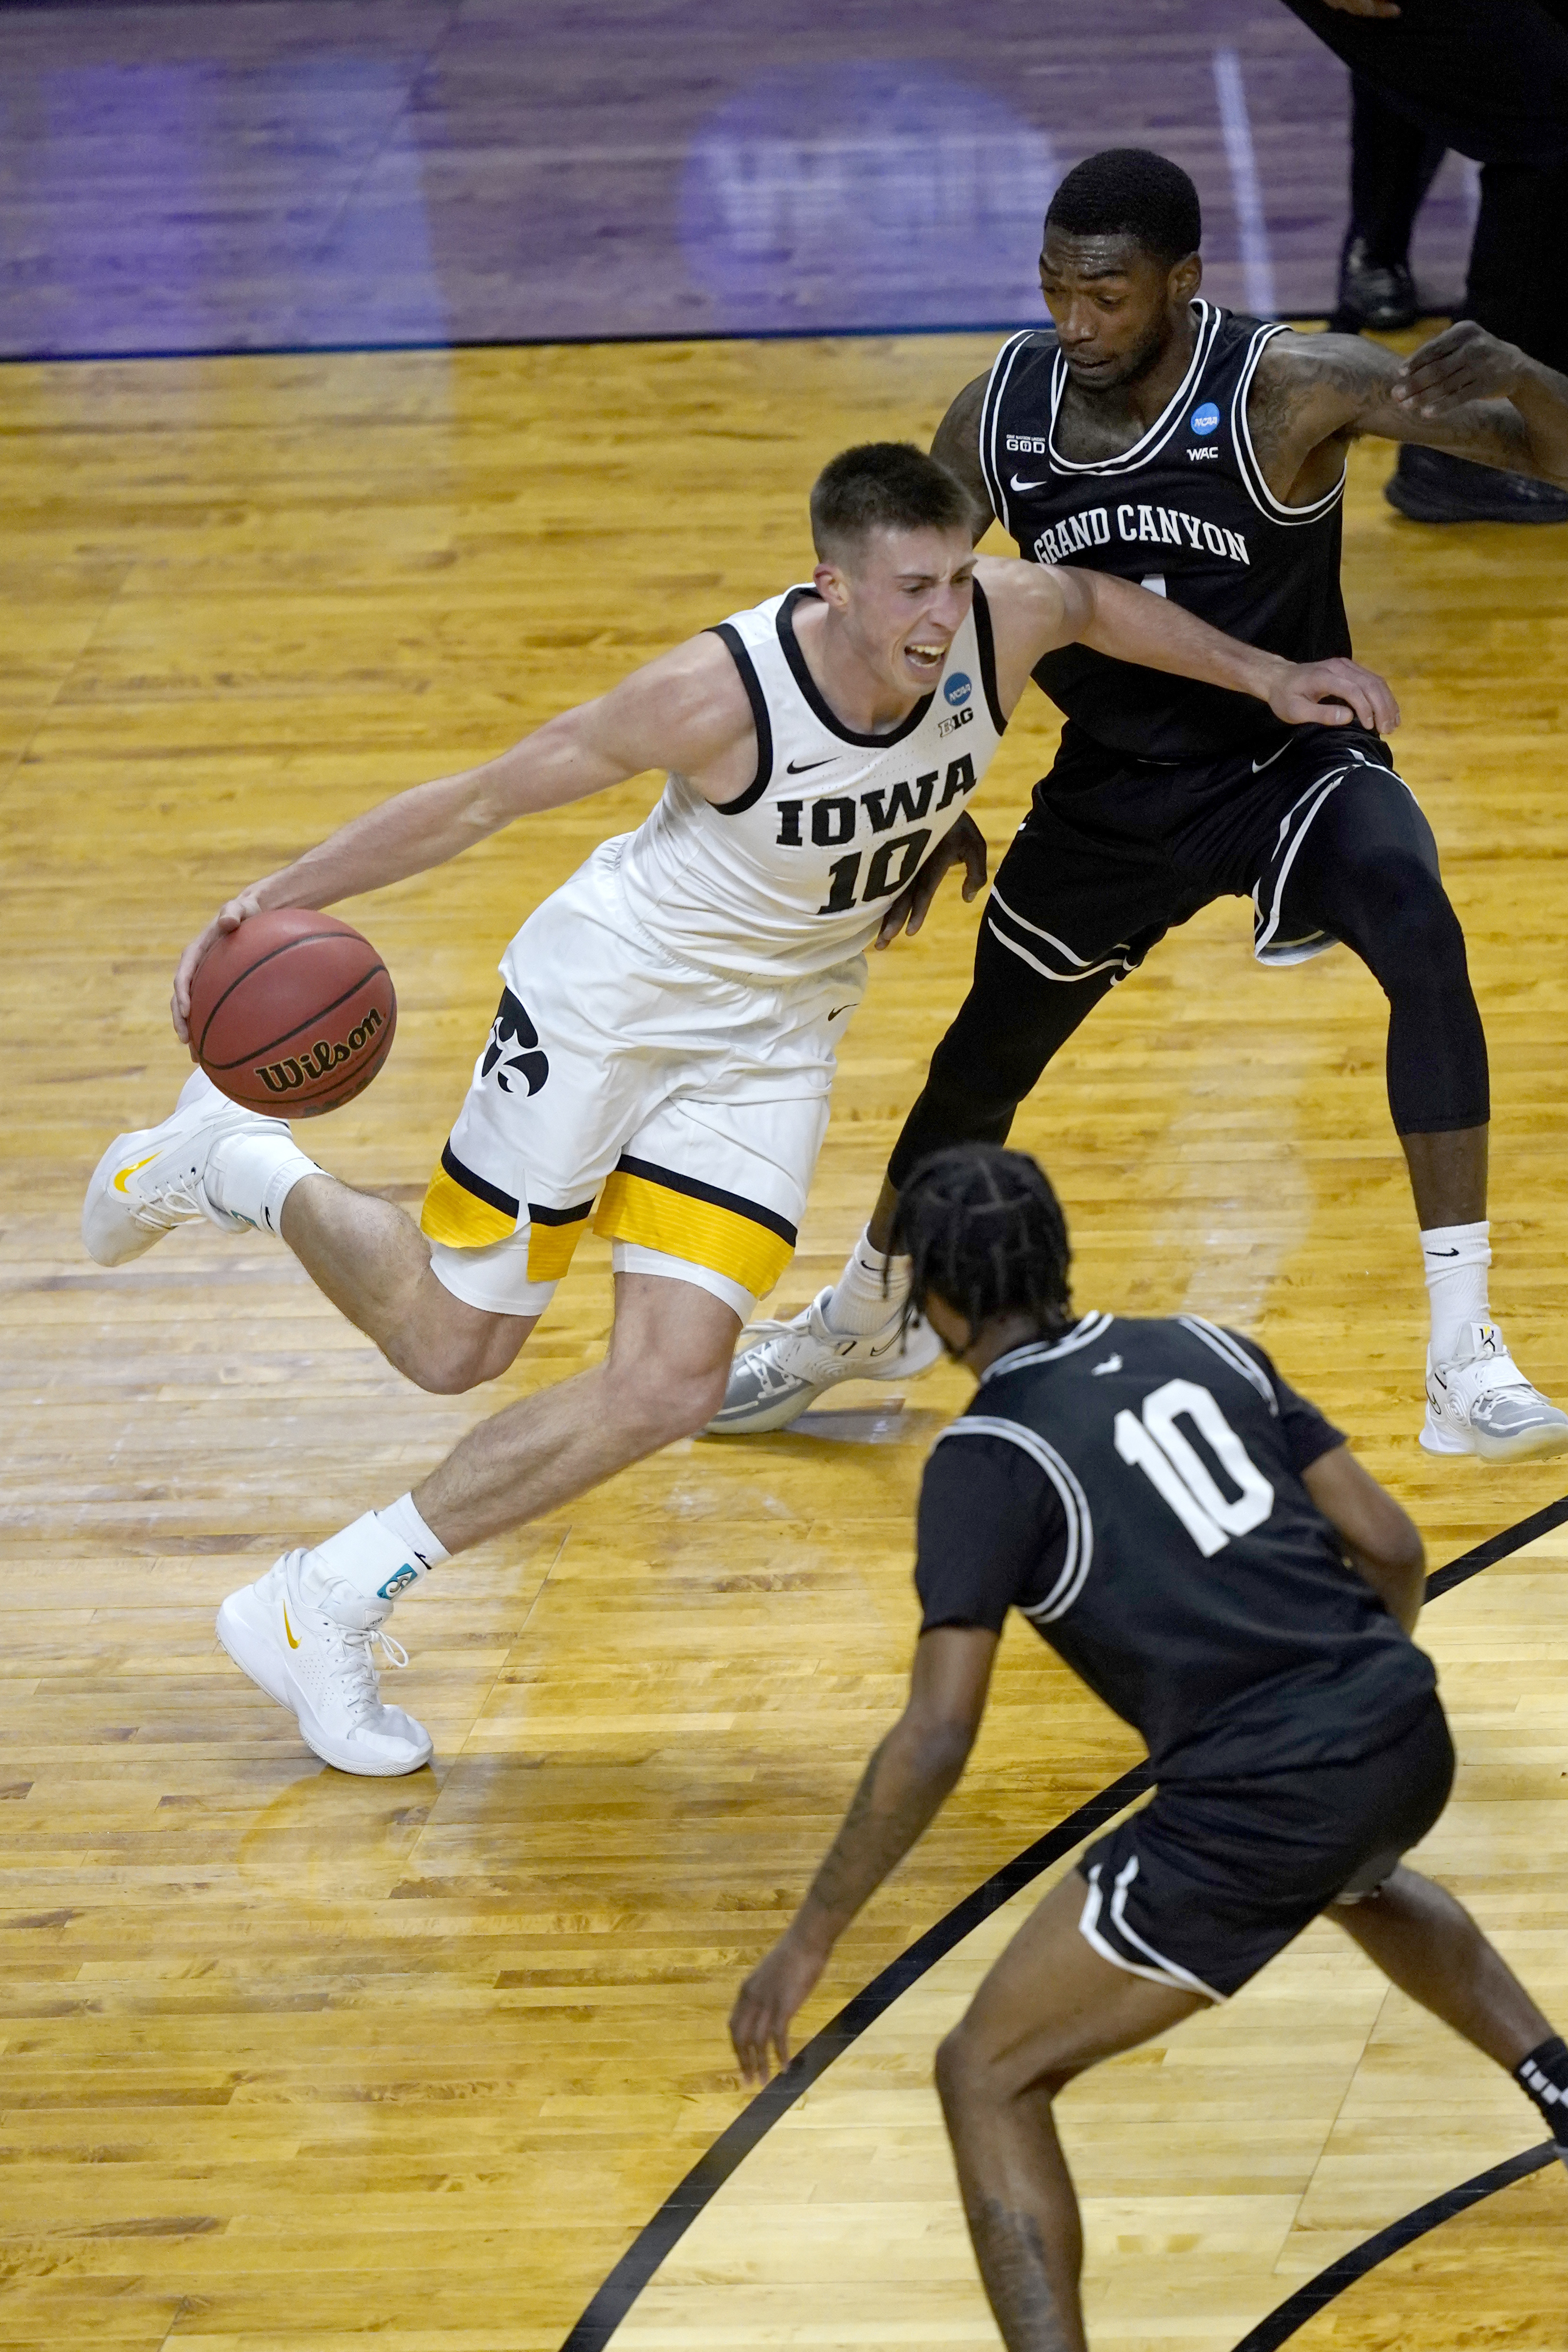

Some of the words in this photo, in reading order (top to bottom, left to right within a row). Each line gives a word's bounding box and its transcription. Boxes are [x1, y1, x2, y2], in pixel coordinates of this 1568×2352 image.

[1006, 439, 1045, 453] GOD
[1186, 447, 1218, 461] WAC
[1194, 416, 1218, 427] NCAA
[1034, 507, 1111, 565] GRAND
[1117, 504, 1250, 565] CANYON
[776, 753, 977, 846] IOWA
[816, 828, 932, 915] 10
[254, 1008, 382, 1092] Wilson
[1114, 1378, 1275, 1557] 10
